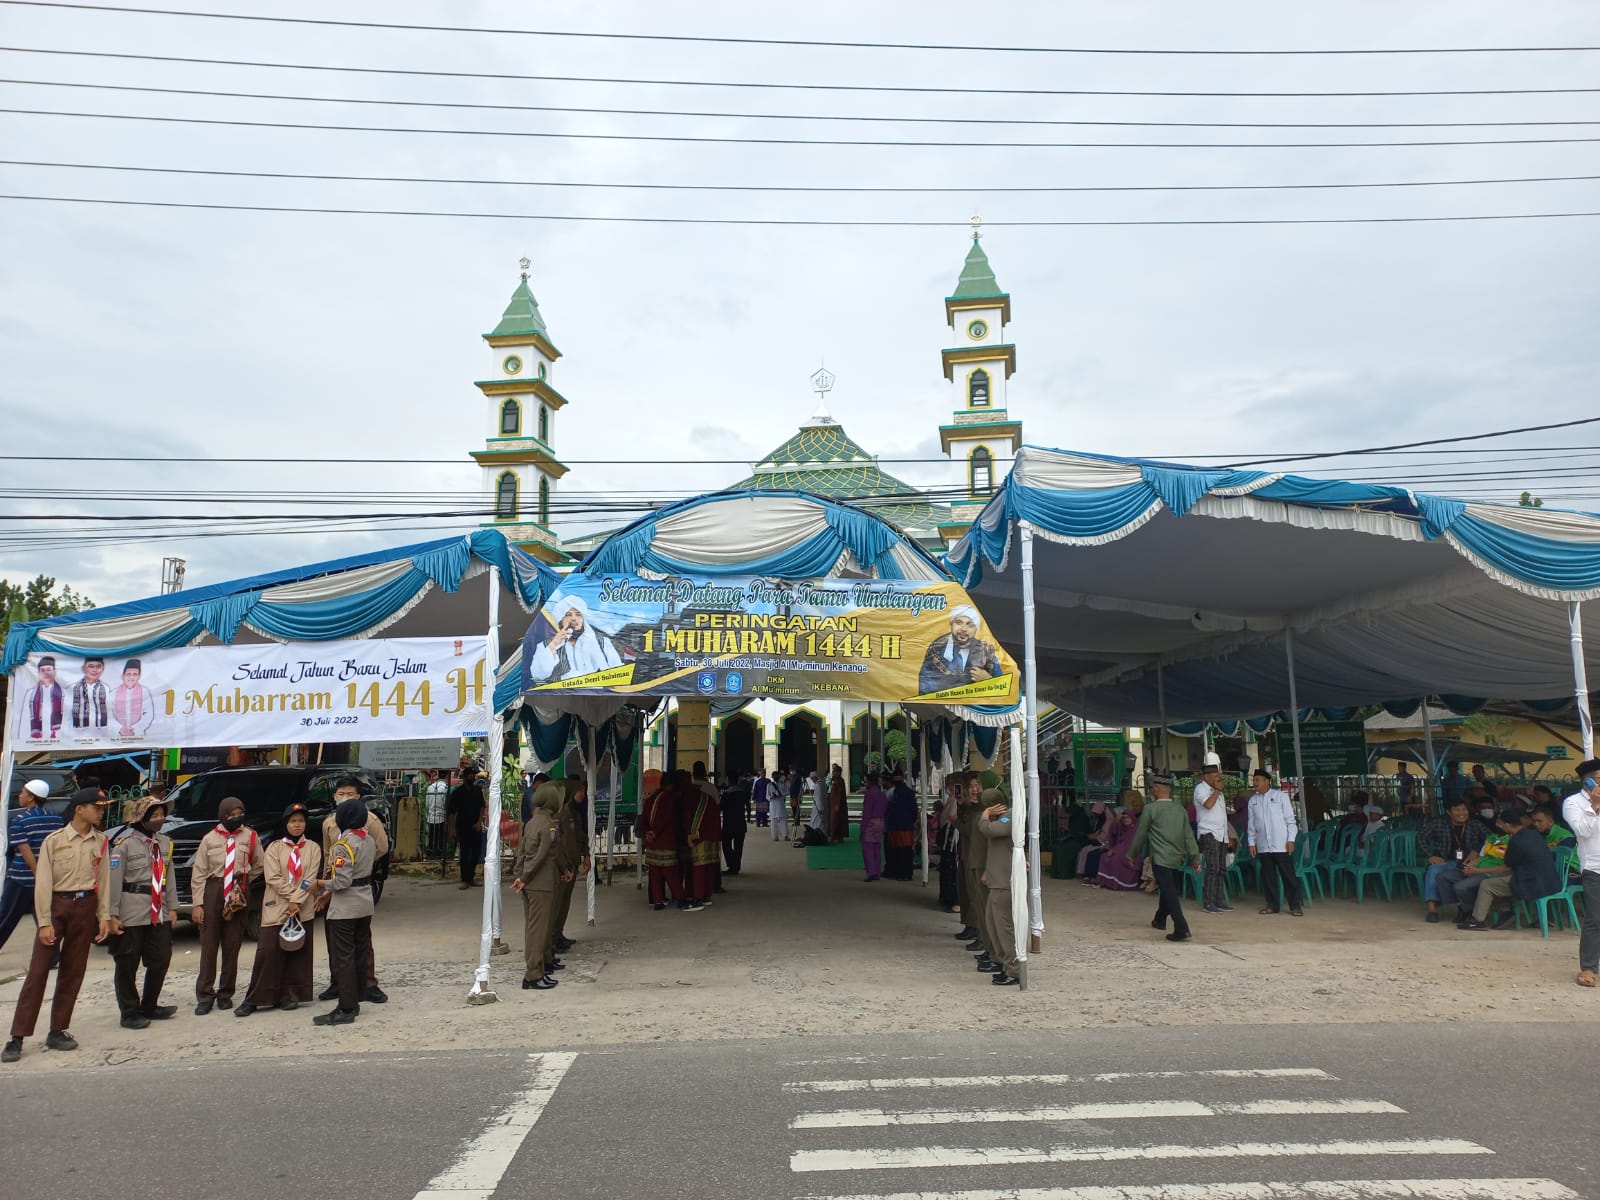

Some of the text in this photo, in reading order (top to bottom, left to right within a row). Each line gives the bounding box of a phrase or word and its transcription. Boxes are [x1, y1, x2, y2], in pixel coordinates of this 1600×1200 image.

[600, 578, 947, 617] Selamat Datang Para Tamu Undangan
[695, 613, 858, 632] PERINGATAN
[642, 629, 902, 659] 1 MUHARAM 1444 H
[232, 658, 428, 683] Selamat Tahun Baru Islam
[675, 658, 700, 669] Sabtu,
[703, 658, 712, 668] 30
[714, 658, 729, 668] Juli
[731, 659, 752, 669] 2022,
[754, 659, 779, 671] Masjid
[780, 660, 789, 670] Al
[832, 662, 868, 673] Kenanga
[161, 658, 487, 717] 1 Muharram 1444 H
[811, 684, 850, 692] IKEBANA
[300, 716, 358, 726] 30 Juli 2022
